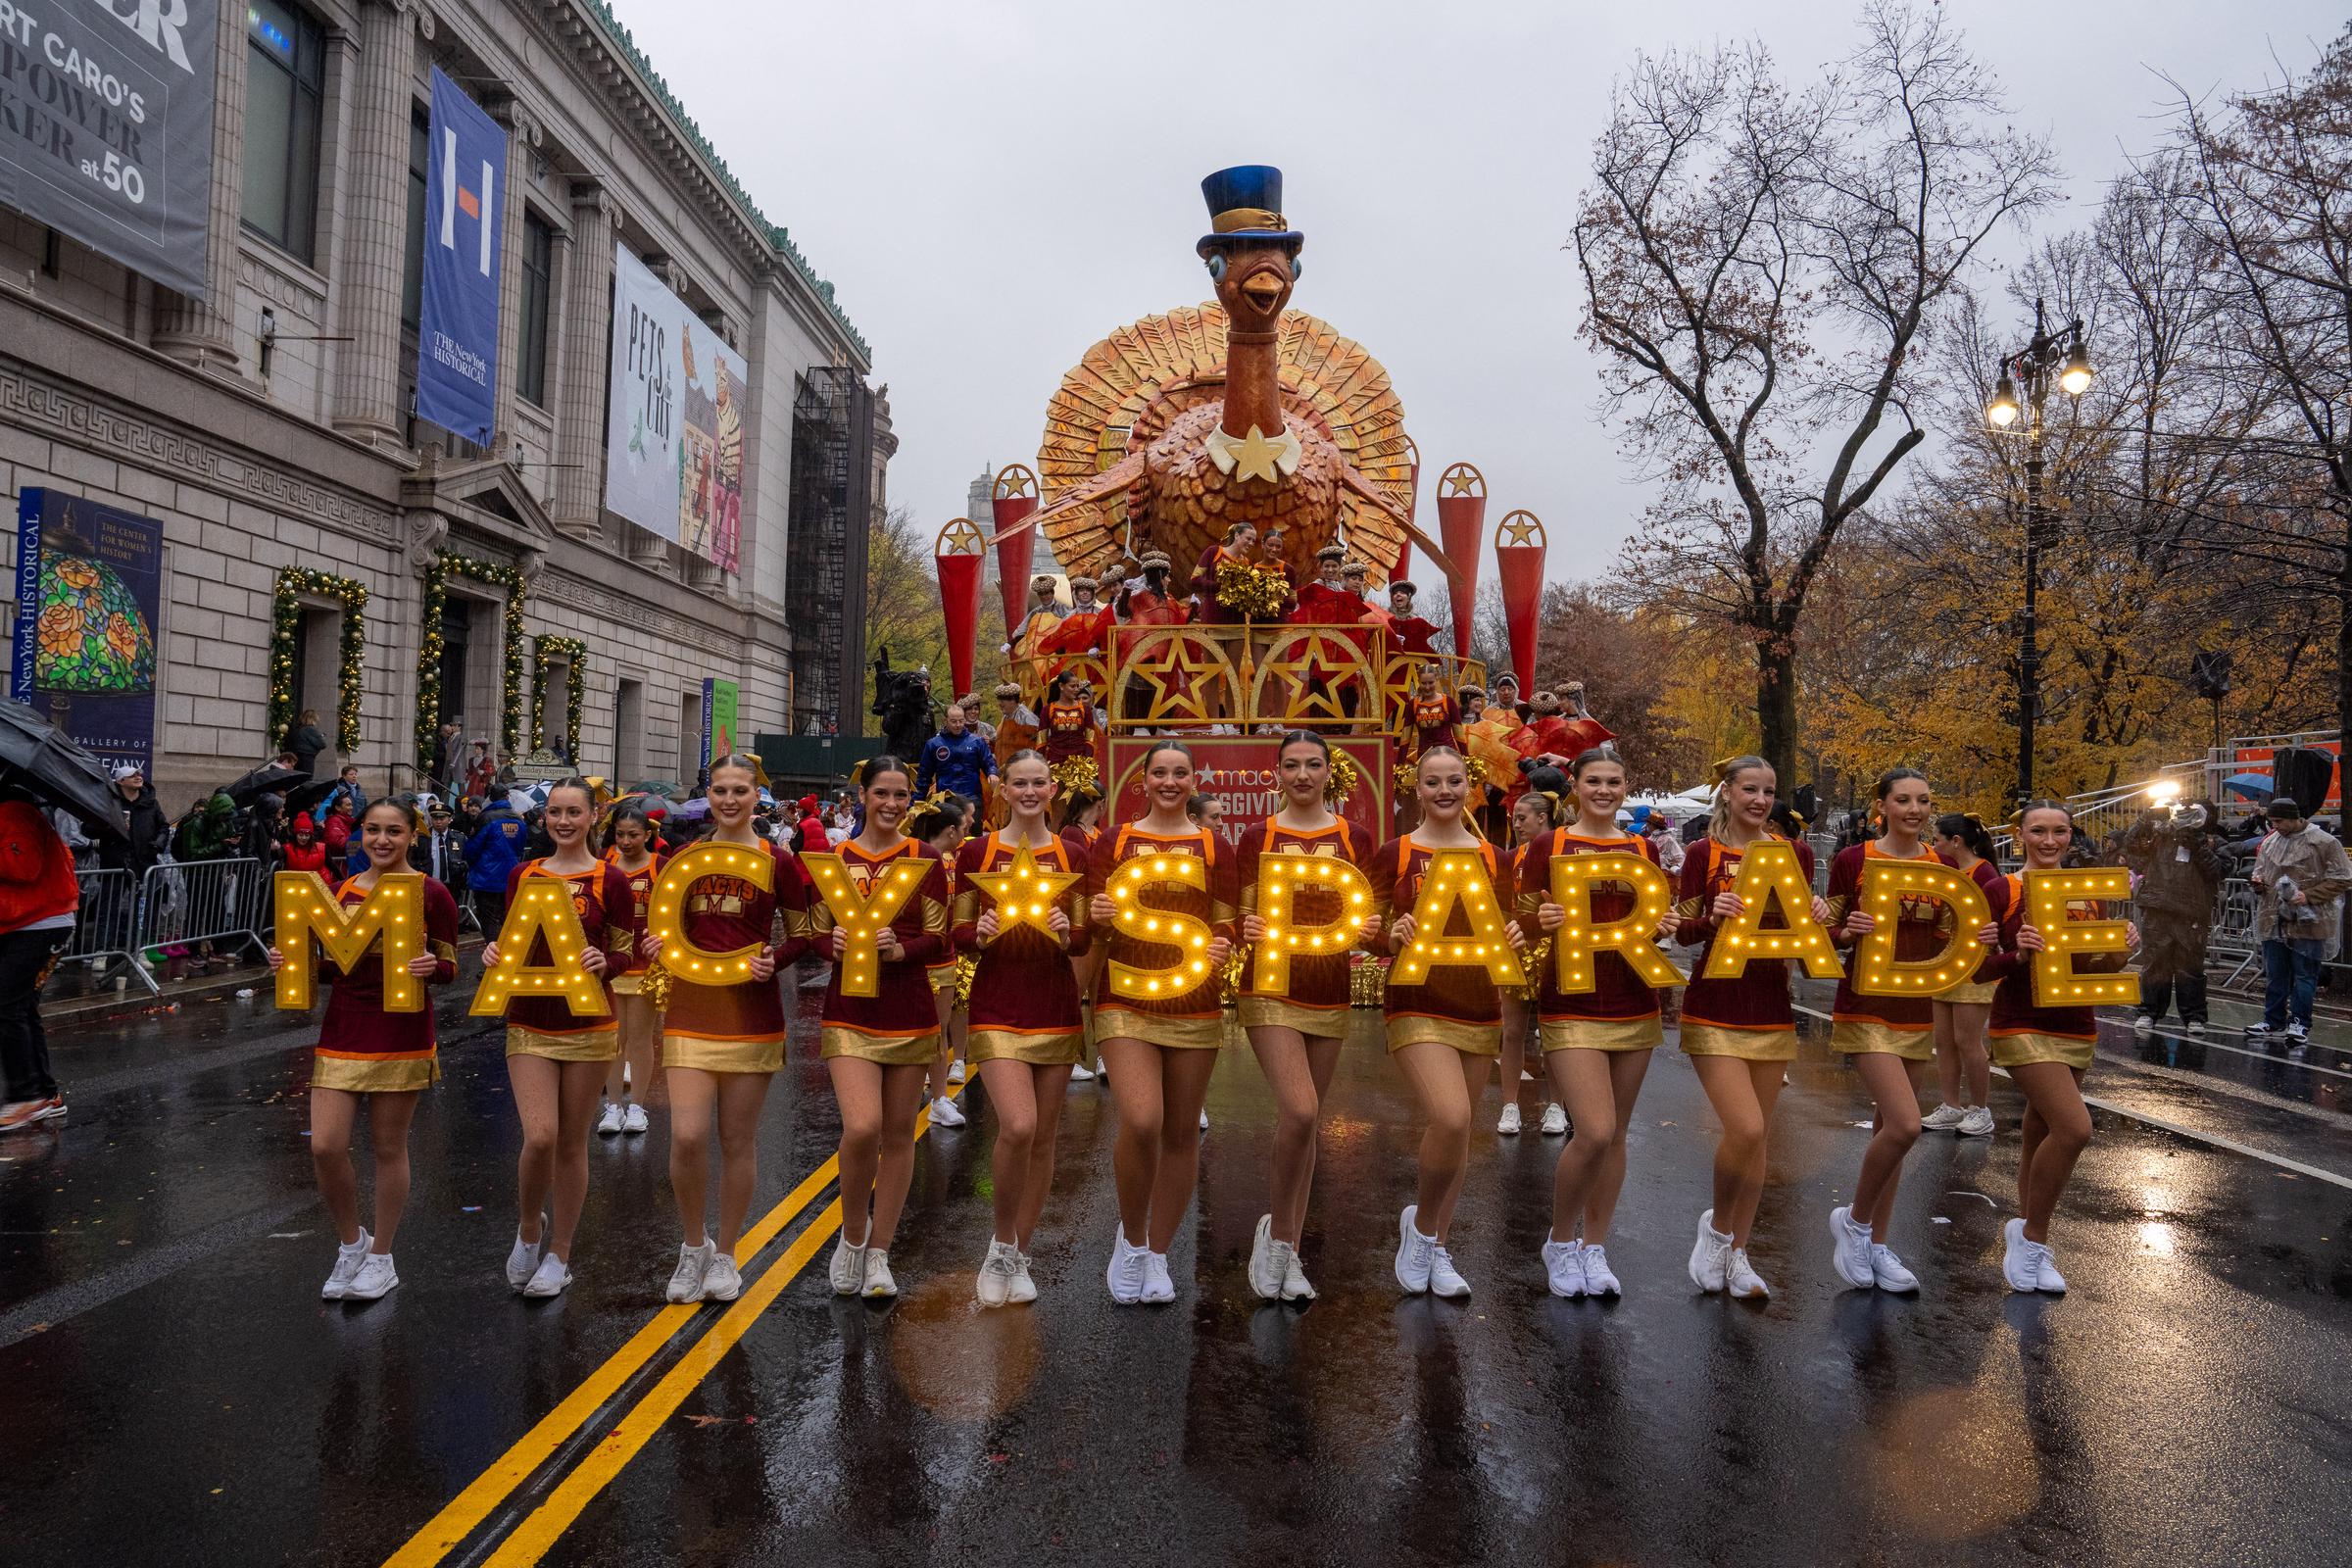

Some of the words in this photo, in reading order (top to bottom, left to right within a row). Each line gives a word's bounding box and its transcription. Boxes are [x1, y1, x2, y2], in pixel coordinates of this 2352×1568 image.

[44, 33, 145, 123] CARO'S
[2, 39, 143, 166] POWER
[81, 159, 100, 181] at
[103, 151, 144, 204] 50
[434, 330, 454, 354] THE
[628, 302, 664, 394] PETS
[434, 346, 486, 387] HISTORICAL
[101, 522, 118, 534] THE
[119, 528, 147, 541] CENTER
[101, 534, 116, 545] FOR
[22, 514, 39, 621] HISTORICAL
[100, 546, 131, 561] HISTORY
[74, 737, 126, 747] GALLERY
[502, 822, 518, 832] NYPD
[690, 875, 757, 903] ACYS
